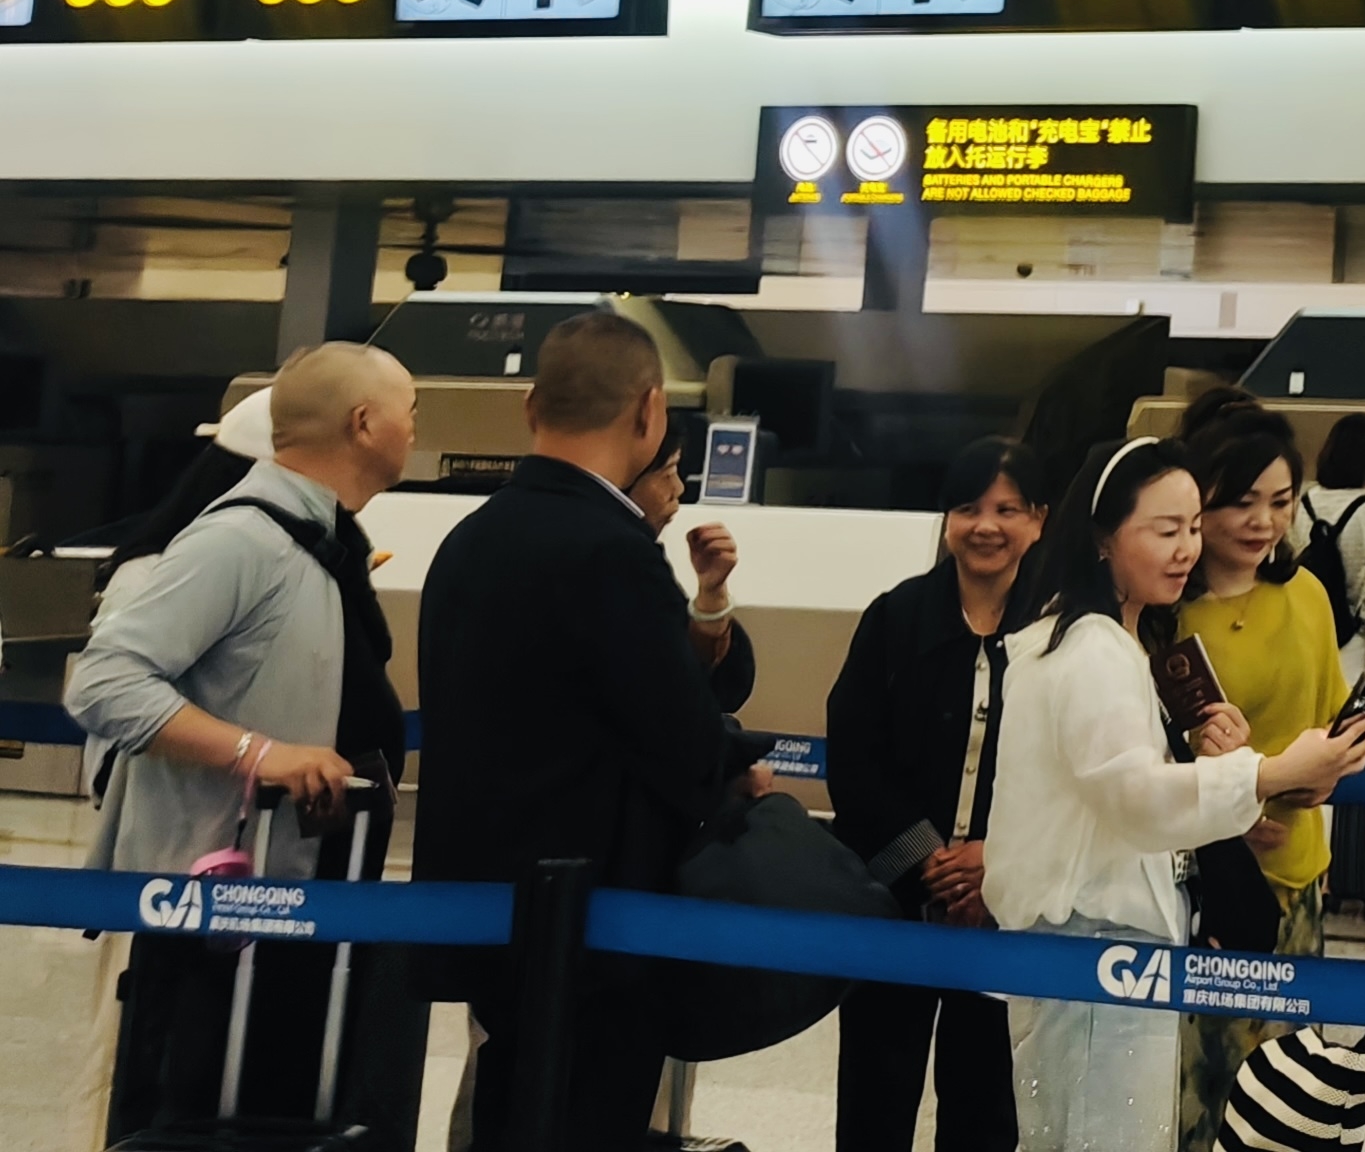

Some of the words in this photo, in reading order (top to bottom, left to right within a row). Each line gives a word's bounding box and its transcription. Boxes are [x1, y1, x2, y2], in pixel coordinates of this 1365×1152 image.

[923, 145, 1049, 170] 放入托运行李
[922, 174, 979, 187] BATTERIES
[982, 174, 1005, 187] AND
[1006, 175, 1061, 187] PORTABLE
[1063, 175, 1123, 188] CHARGERS
[922, 188, 945, 201] ARE
[947, 188, 970, 201] NOT
[971, 188, 1022, 201] ALLOWED
[1024, 188, 1074, 201] CHECKED
[1076, 188, 1131, 202] BAGGAGE
[212, 884, 305, 907] CHONGQING
[1184, 954, 1295, 983] CHONGQING
[1183, 989, 1310, 1015] 重庆机场集团有限公司
